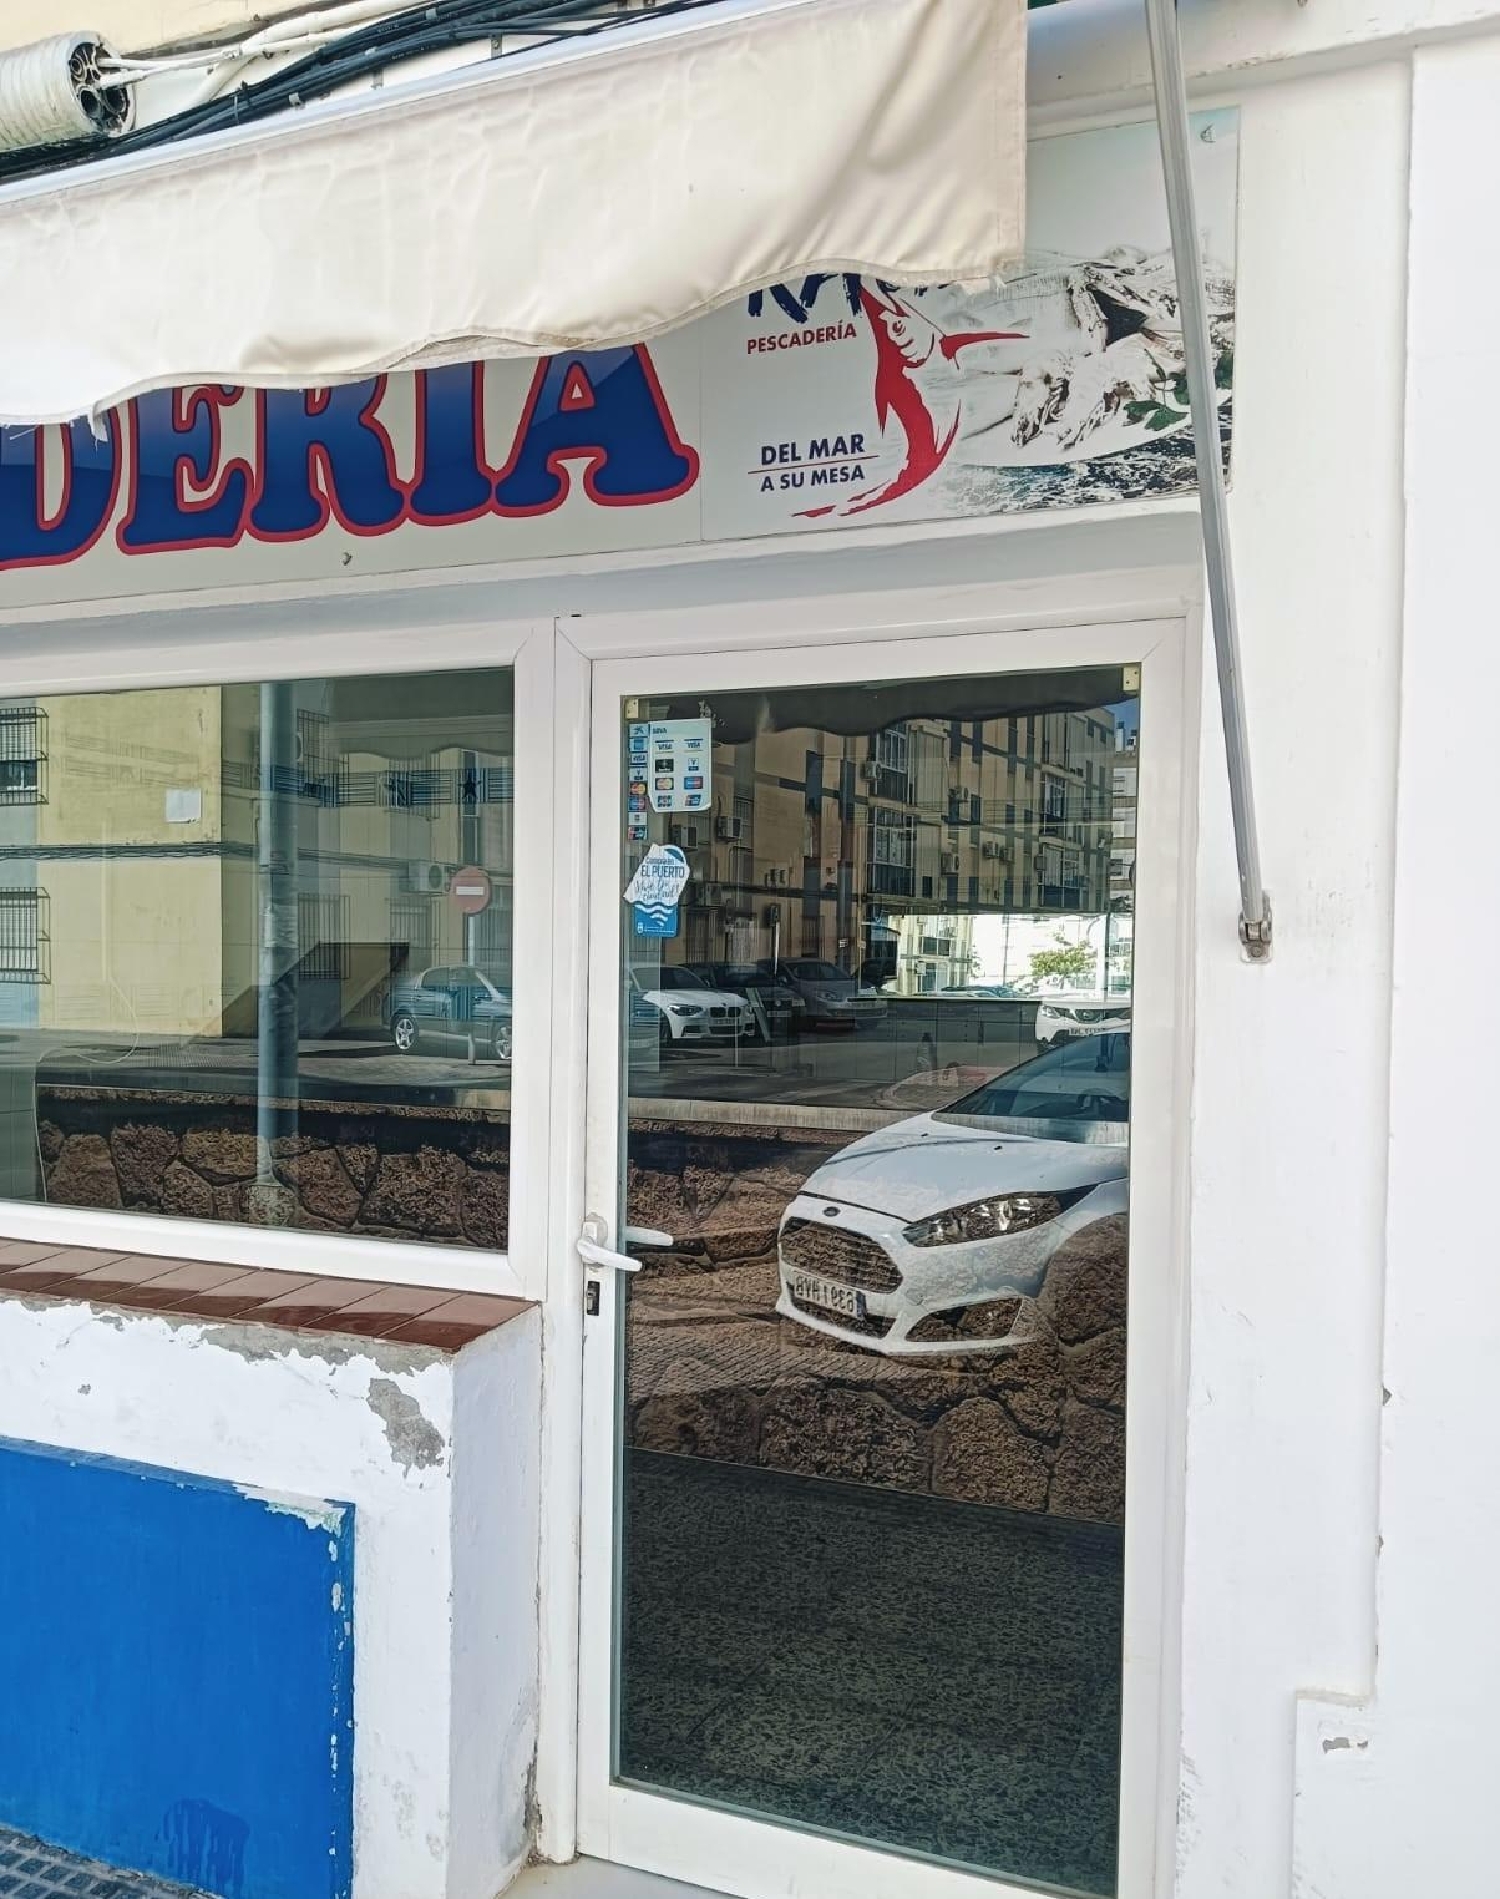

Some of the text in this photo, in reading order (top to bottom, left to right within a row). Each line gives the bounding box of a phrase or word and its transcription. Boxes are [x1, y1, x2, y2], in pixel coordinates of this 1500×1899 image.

[747, 320, 857, 354] PESCADERÍA
[761, 433, 865, 466] DEL MAR
[760, 464, 864, 492] A SU MESA
[641, 865, 685, 878] EL PUERTO
